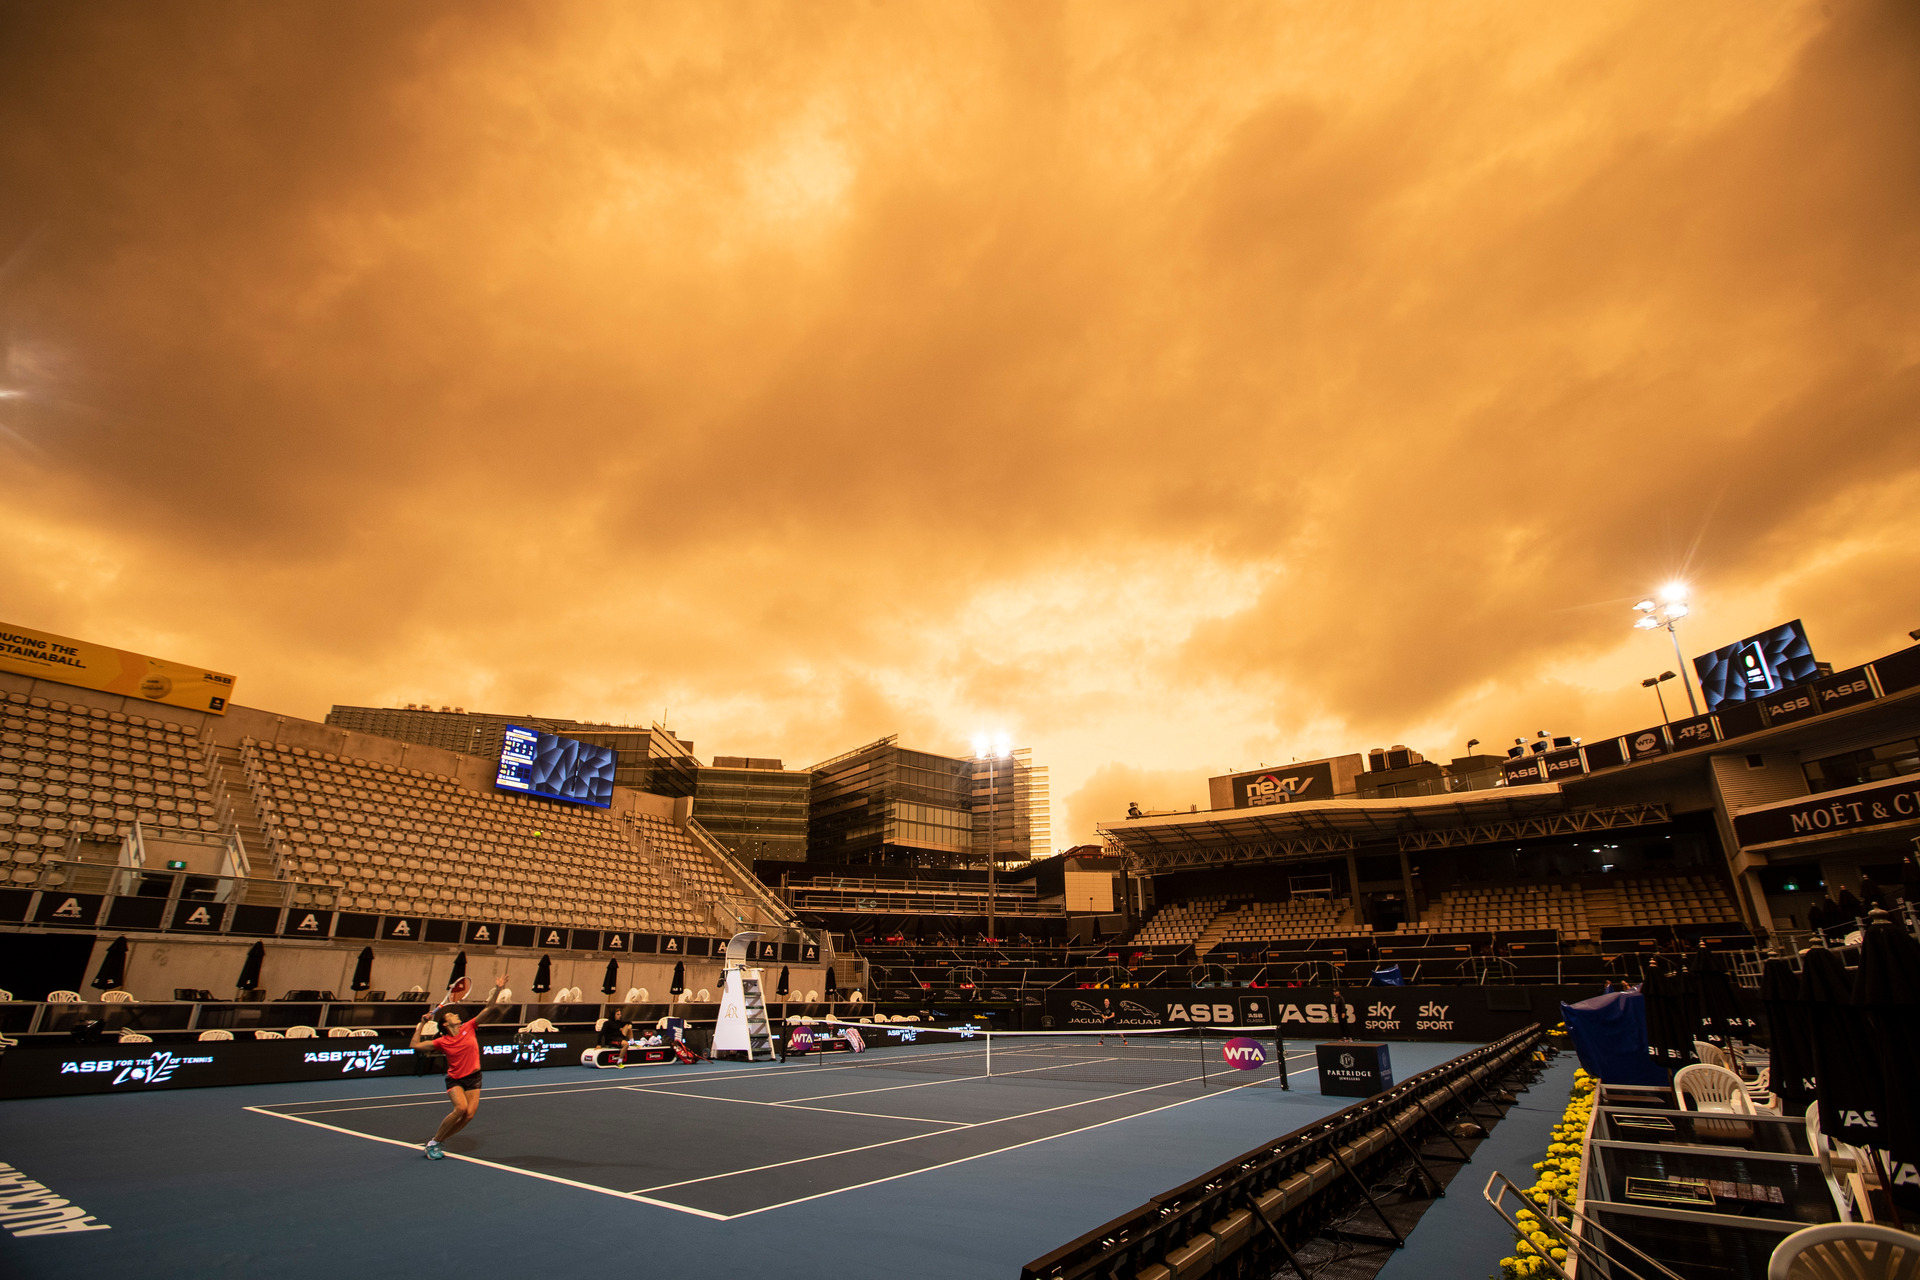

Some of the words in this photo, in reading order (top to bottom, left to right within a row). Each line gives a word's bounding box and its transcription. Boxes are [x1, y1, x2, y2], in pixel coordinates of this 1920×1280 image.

[51, 643, 79, 656] THE
[1822, 680, 1868, 701] ASB
[1769, 697, 1811, 716] ASB
[1636, 738, 1656, 748] WTA
[1547, 757, 1580, 772] ASB
[1507, 765, 1538, 780] ASB
[1790, 801, 1864, 833] MOËT
[1872, 802, 1890, 819] &
[1167, 1003, 1235, 1023] ASB
[1367, 1001, 1396, 1020] sky
[1418, 1001, 1449, 1020] sky
[1365, 1020, 1400, 1030] SPORT
[1416, 1020, 1454, 1030] SPORT
[792, 1033, 813, 1043] WTA
[304, 1051, 342, 1063] ASB
[483, 1044, 512, 1055] ASB
[1224, 1046, 1264, 1061] WTA
[60, 1060, 114, 1074] ASB
[114, 1059, 134, 1067] FOR
[135, 1058, 154, 1066] THE
[169, 1057, 182, 1065] OF
[182, 1056, 214, 1064] TENNIS
[1327, 1069, 1372, 1078] PARTRIDGE
